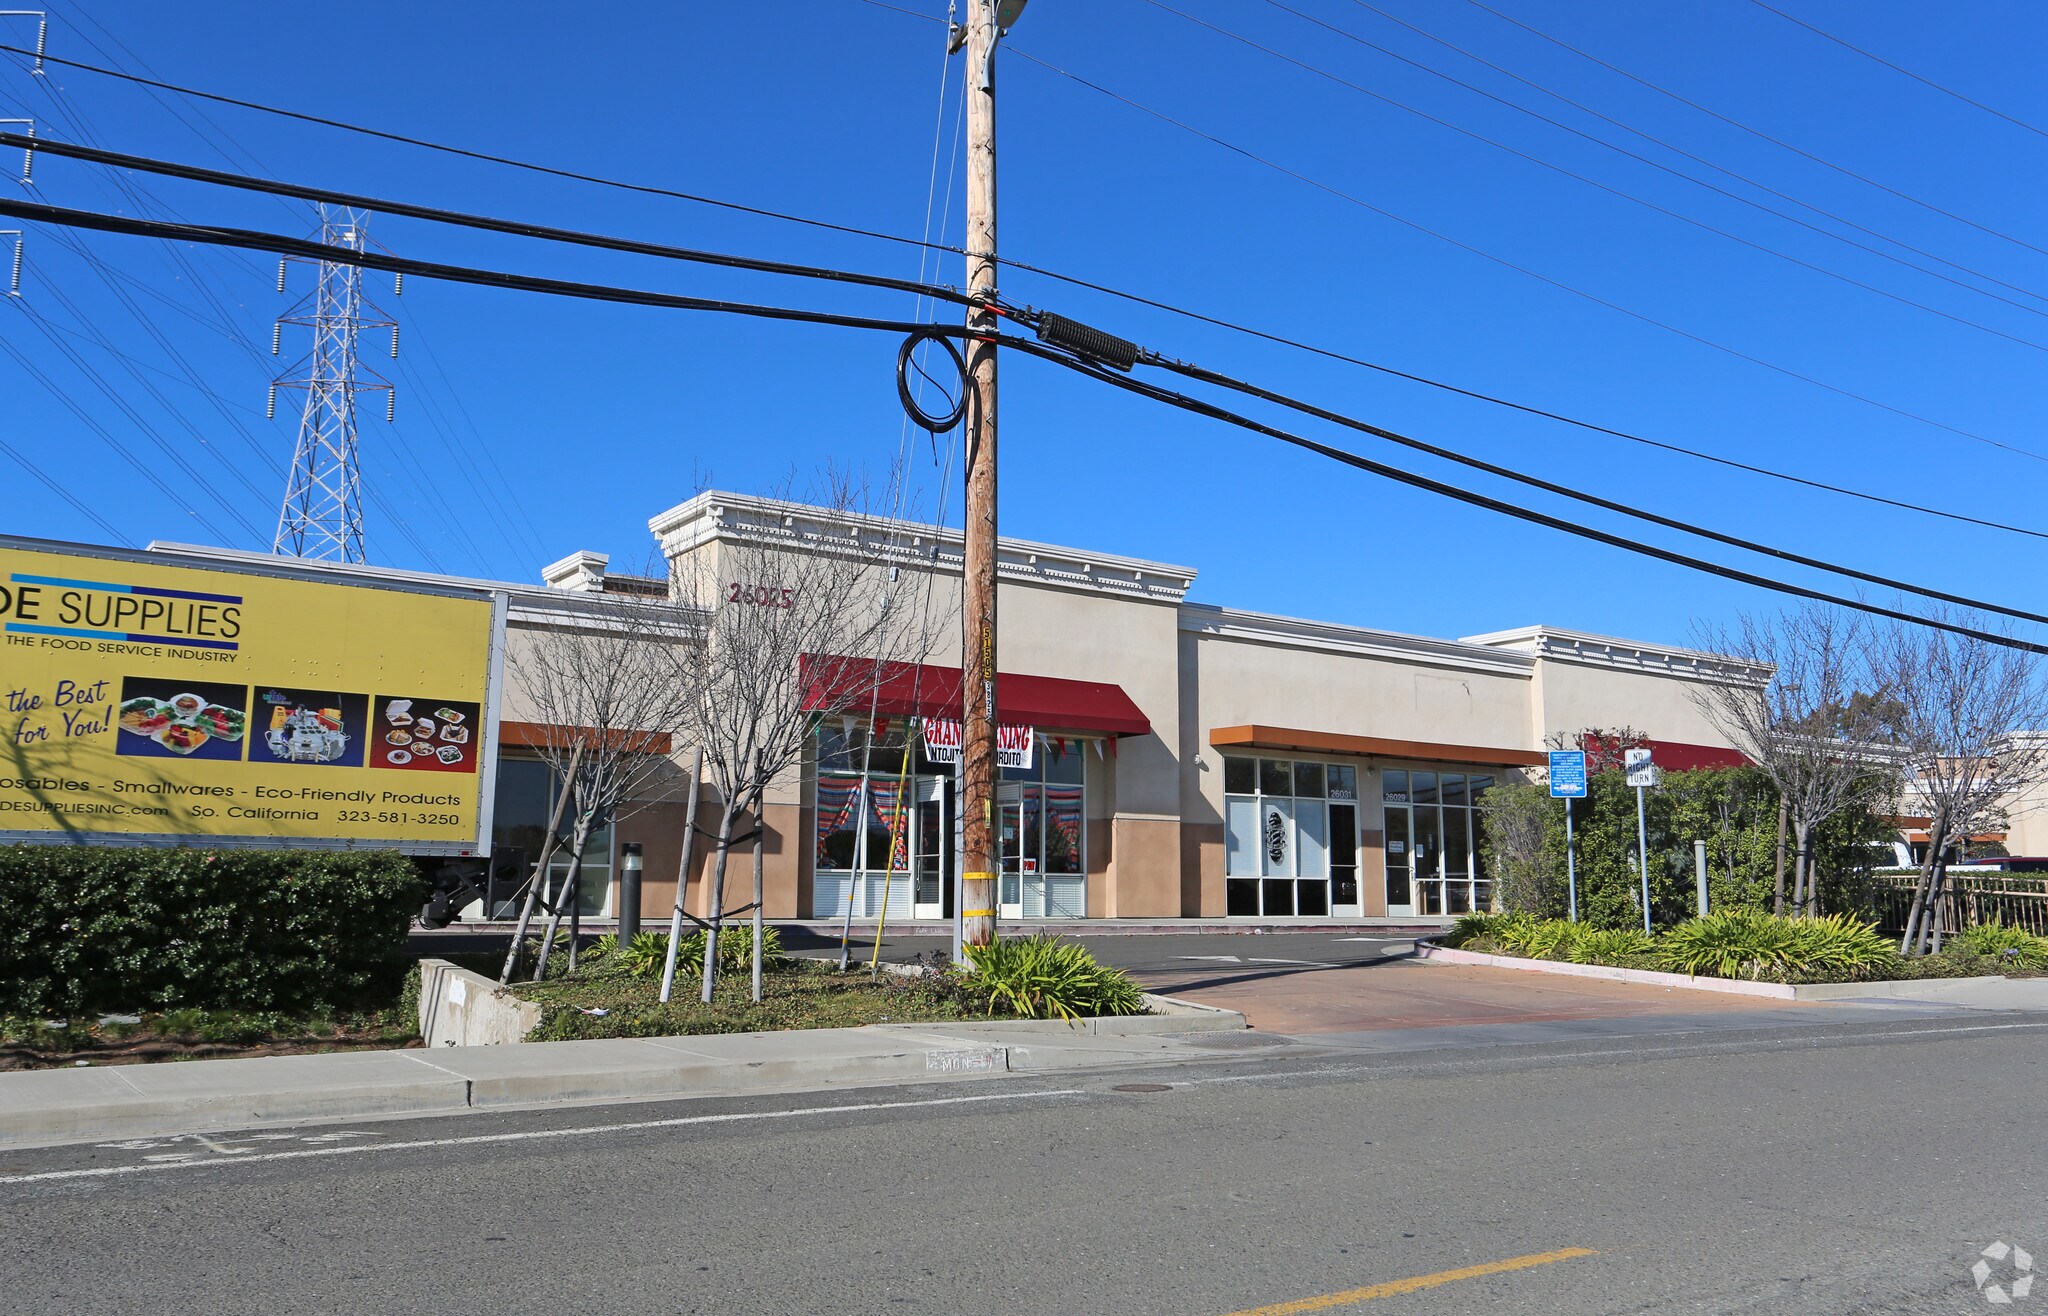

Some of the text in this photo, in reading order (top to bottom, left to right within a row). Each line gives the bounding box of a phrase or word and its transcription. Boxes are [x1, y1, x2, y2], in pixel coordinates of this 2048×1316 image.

[59, 591, 241, 638] SUPPLIES
[6, 635, 238, 663] THE FOOD SERVICE INDUSTRY
[5, 680, 110, 712] the Best
[15, 704, 113, 744] for You!
[997, 725, 1030, 751] NING
[997, 751, 1021, 766] RDITO
[1628, 762, 1649, 772] RIGHT
[1633, 752, 1643, 761] NO
[1629, 774, 1649, 783] TURN
[0, 778, 90, 791] osables
[113, 780, 234, 797] Smallwares
[255, 786, 376, 804] Eco-Friendly
[382, 791, 460, 806] Products
[1330, 789, 1352, 798] 26031
[1385, 793, 1406, 801] 26029
[0, 801, 459, 825] DESUPPLIESINC.com So. California 323-581-3250
